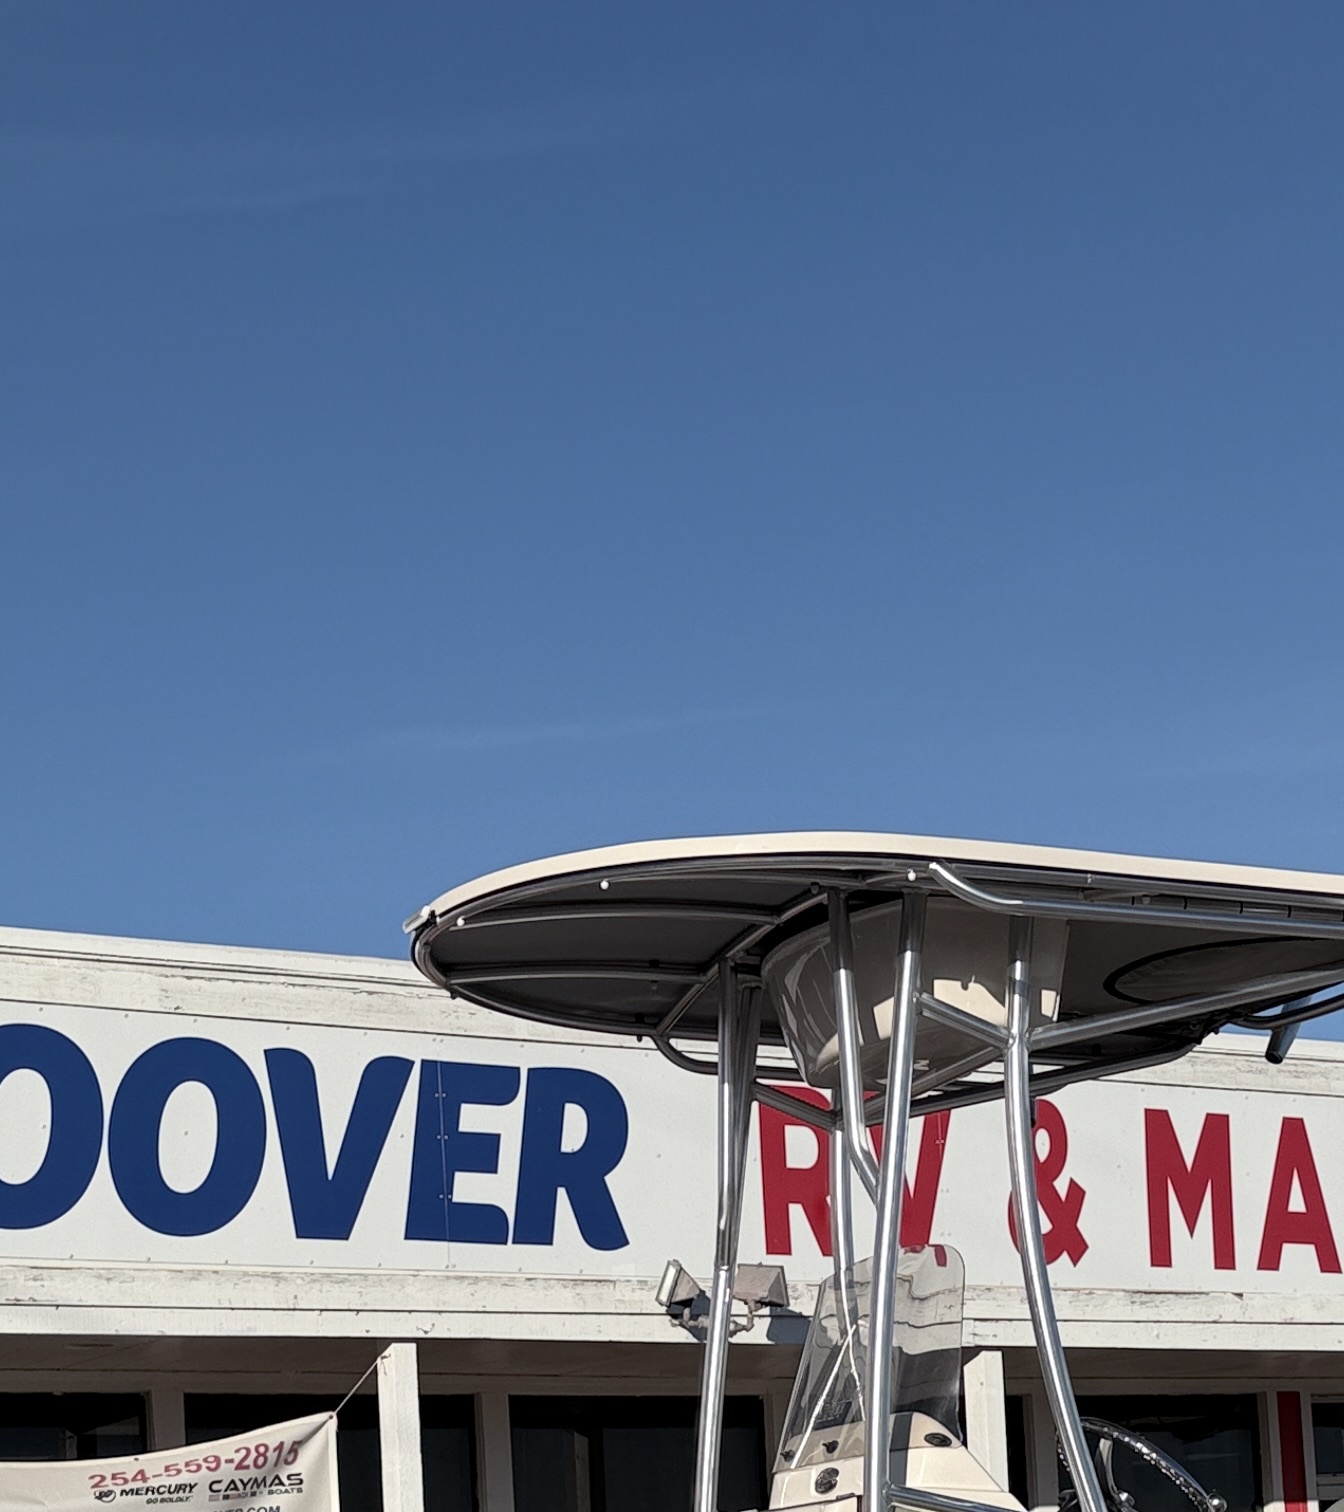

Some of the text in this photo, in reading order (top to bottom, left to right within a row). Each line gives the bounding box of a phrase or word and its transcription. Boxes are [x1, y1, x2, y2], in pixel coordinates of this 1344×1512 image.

[1010, 1099, 1090, 1268] &
[88, 1439, 304, 1490] 254-559-2815
[120, 1482, 198, 1498] MERCURY
[208, 1473, 304, 1494] CAYMAS
[267, 1487, 303, 1496] BOATS
